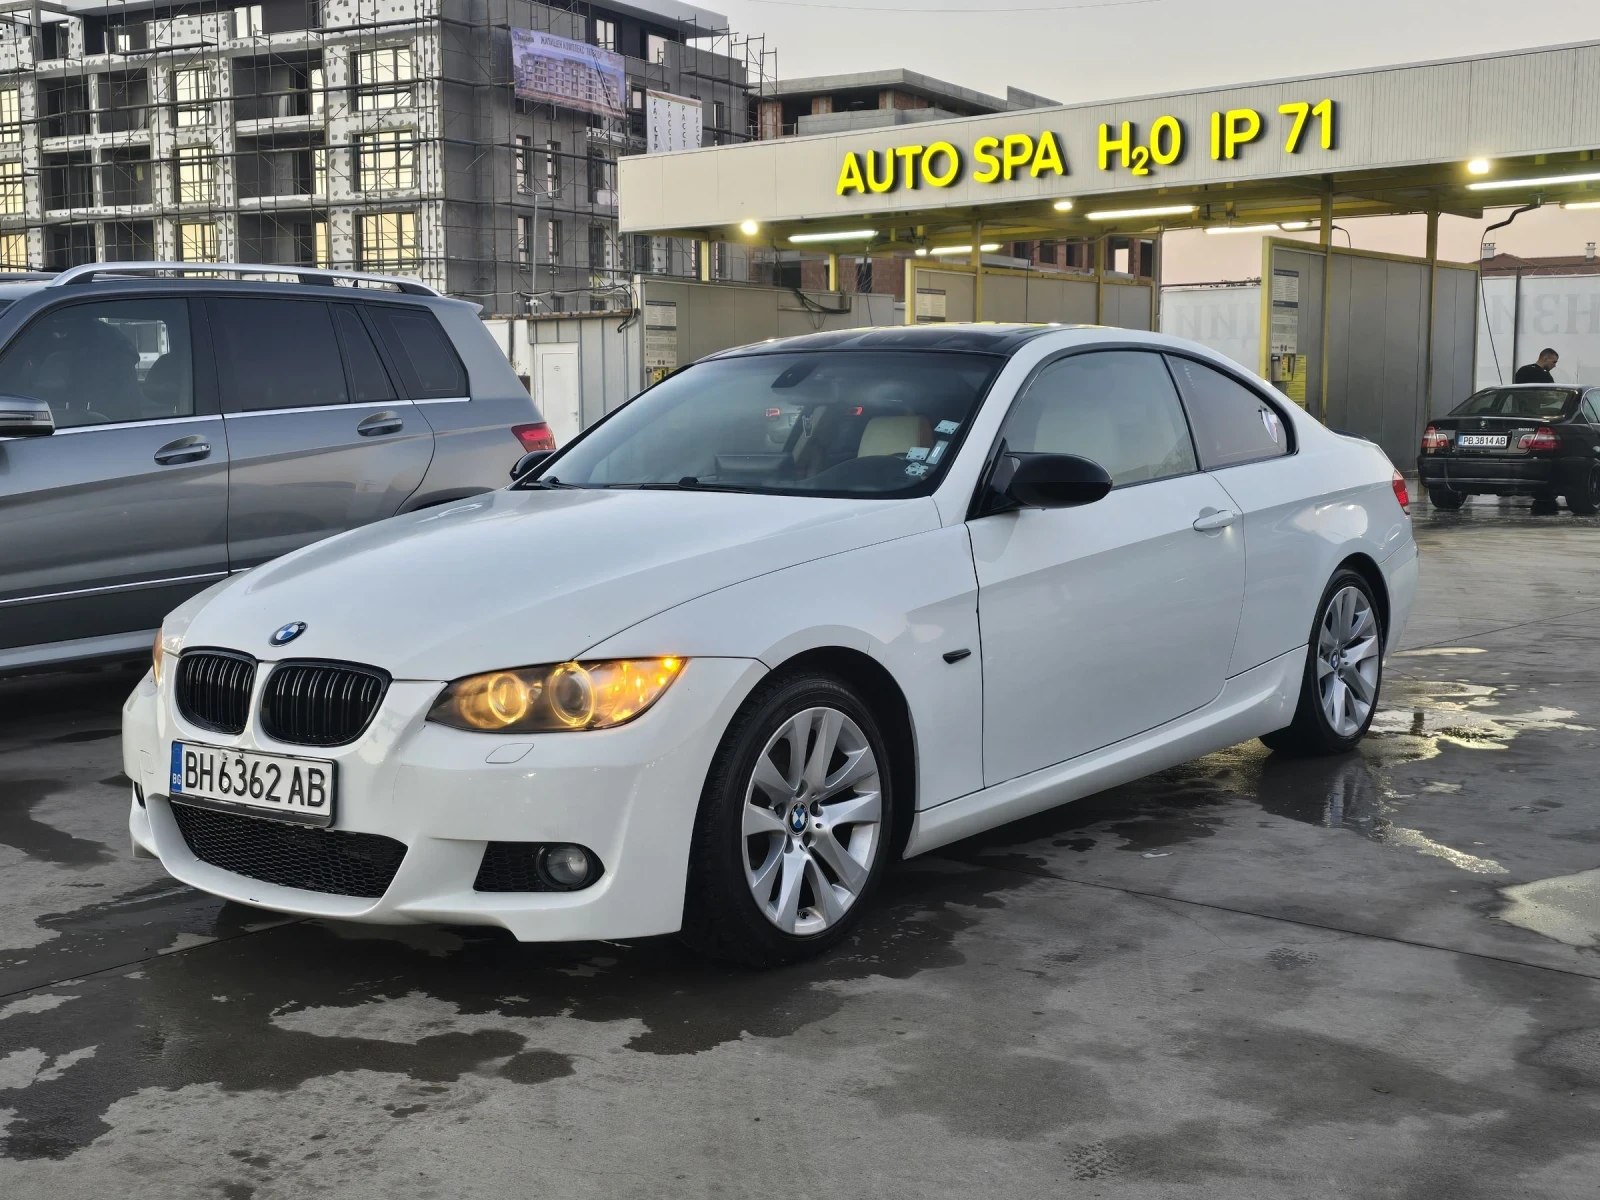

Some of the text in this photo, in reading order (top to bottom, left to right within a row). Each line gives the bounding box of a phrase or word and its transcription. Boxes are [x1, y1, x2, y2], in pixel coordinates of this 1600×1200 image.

[837, 142, 958, 194] AUTO
[974, 132, 1062, 182] SPA
[1211, 109, 1261, 160] IP
[1279, 98, 1333, 153] 71
[1464, 436, 1506, 445] PB 3814 AB
[172, 773, 182, 786] BG
[288, 766, 325, 807] AB
